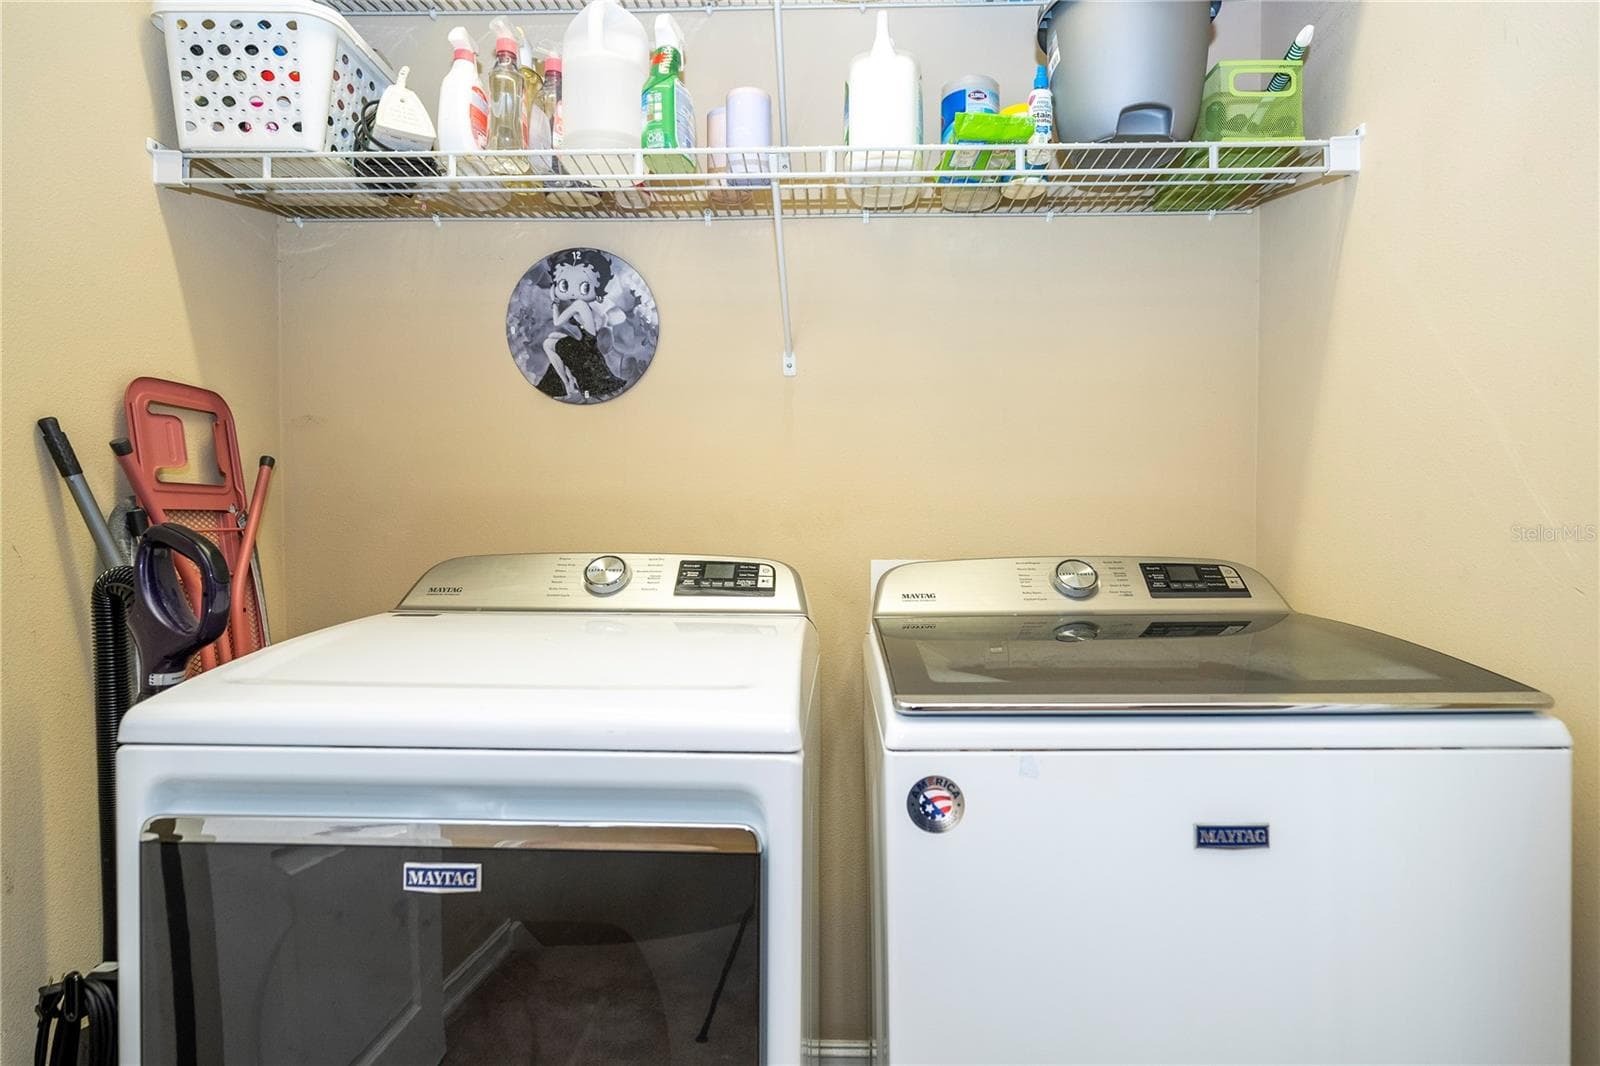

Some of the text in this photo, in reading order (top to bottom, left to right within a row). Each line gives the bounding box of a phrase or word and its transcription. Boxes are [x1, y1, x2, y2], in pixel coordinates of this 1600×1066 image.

[571, 251, 582, 260] 12
[911, 777, 961, 800] AMERICA
[1199, 829, 1266, 844] MAYTAG
[407, 870, 476, 886] MAYTAG
